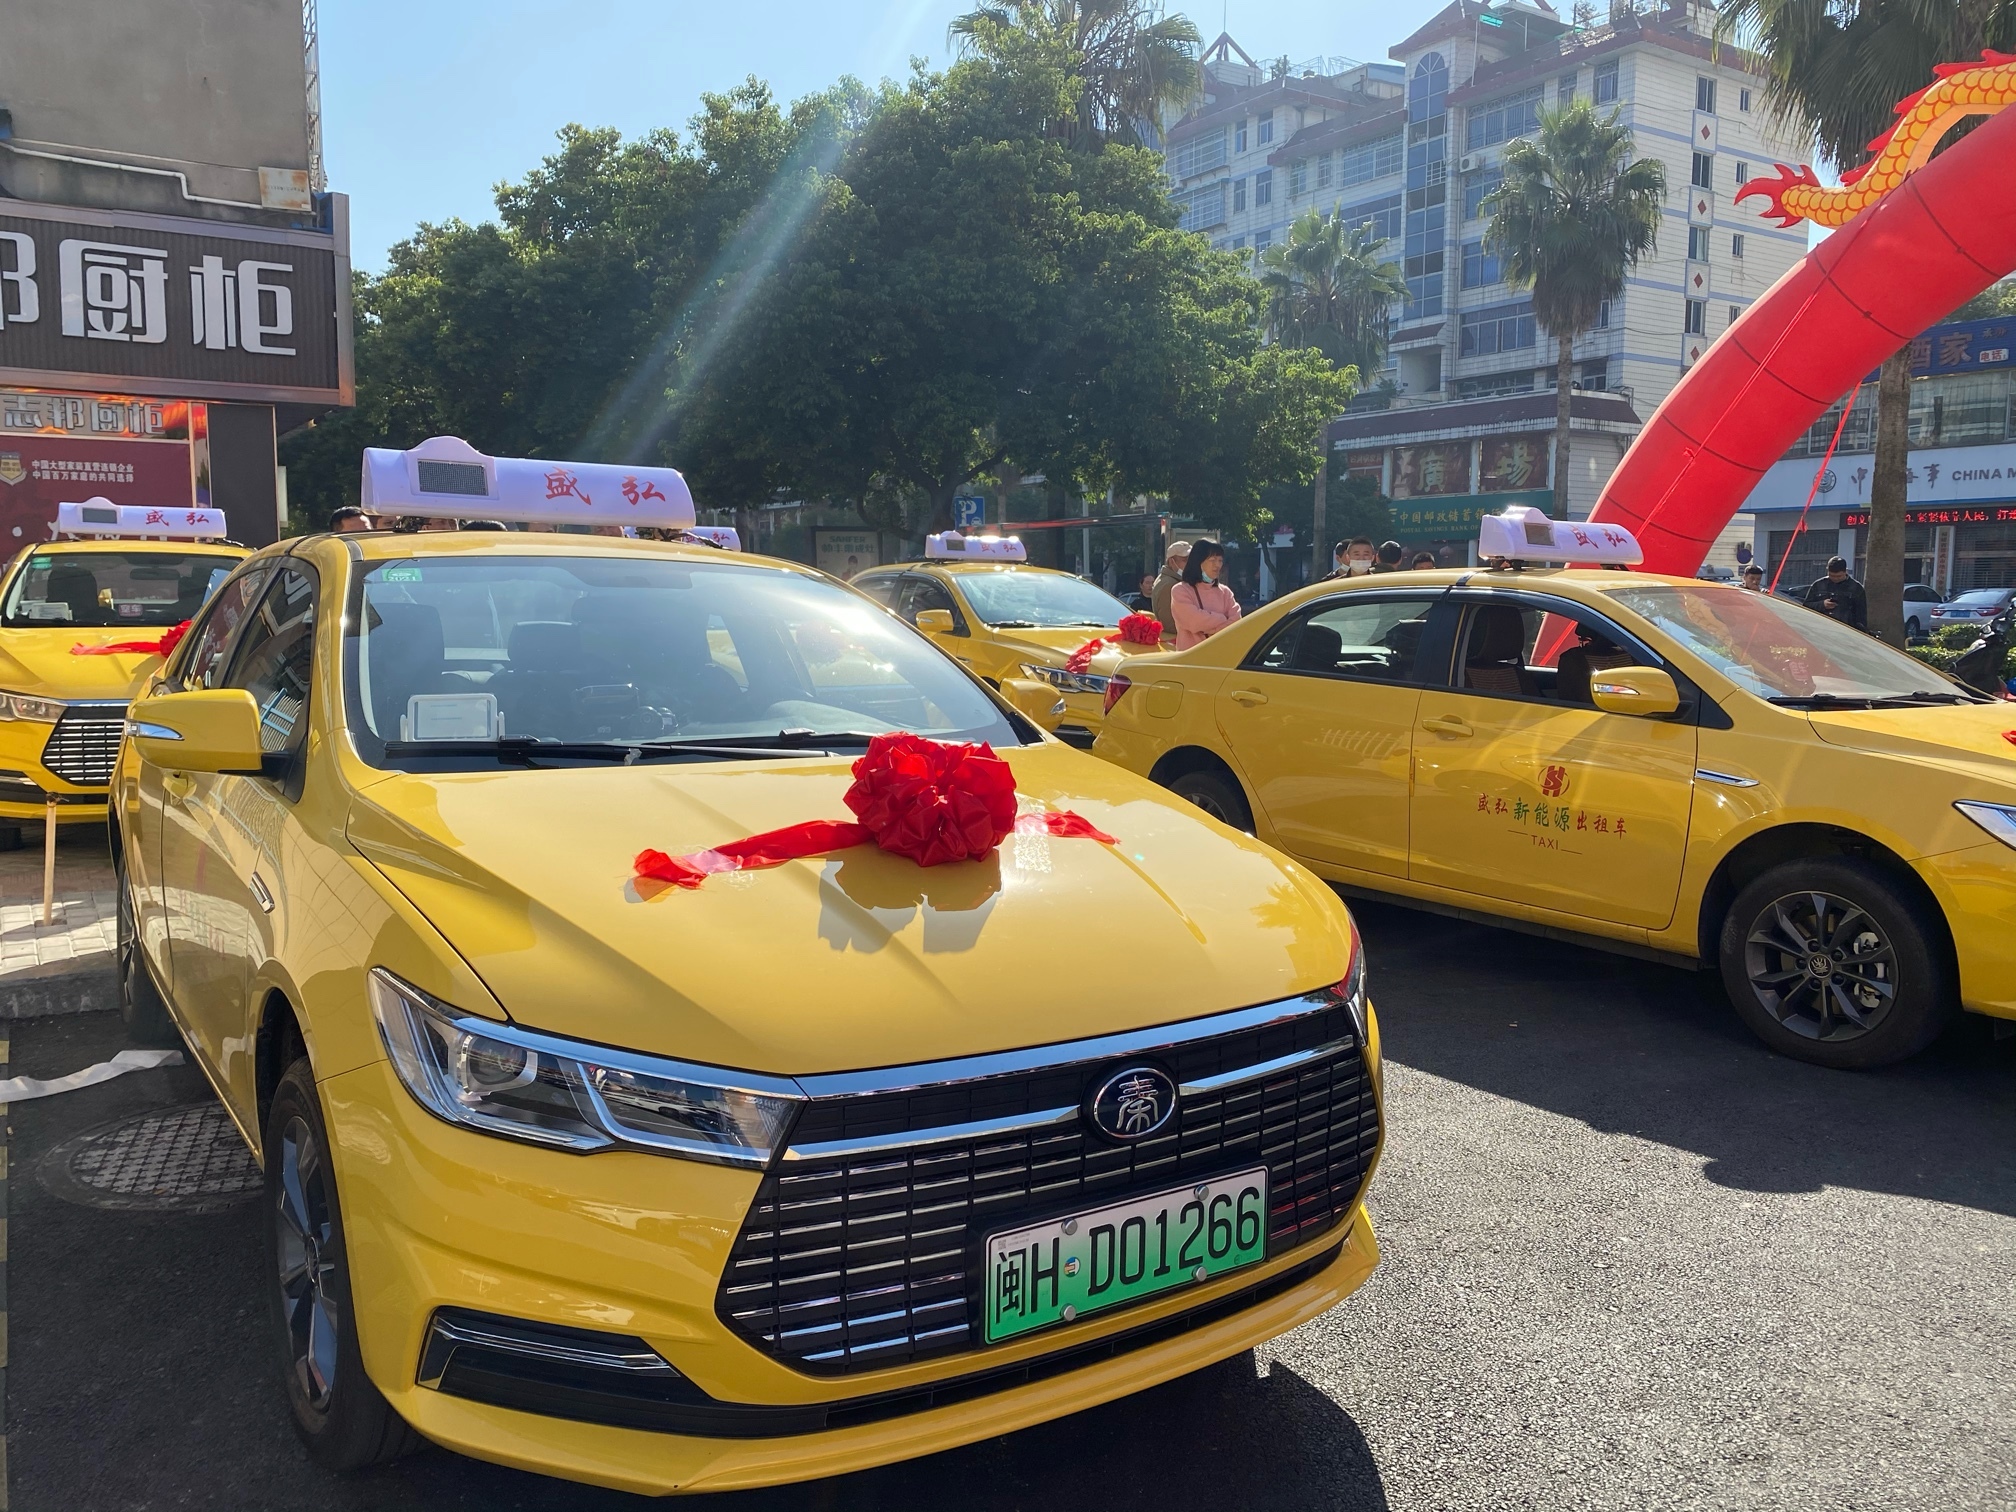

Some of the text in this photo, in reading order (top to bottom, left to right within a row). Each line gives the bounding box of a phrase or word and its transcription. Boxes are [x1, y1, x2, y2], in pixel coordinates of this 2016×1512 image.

[4, 396, 166, 435] 志邦厨柜
[32, 460, 134, 472] 中国大型家装直营连锁企业
[33, 471, 134, 483] 中国百万家庭的共同选择
[1952, 469, 2002, 481] CHINA
[544, 466, 666, 506] 盛弘
[146, 509, 209, 527] 盛弘
[959, 500, 977, 527] P
[1424, 525, 1448, 533] SAVINGS
[1531, 834, 1560, 850] TAXI
